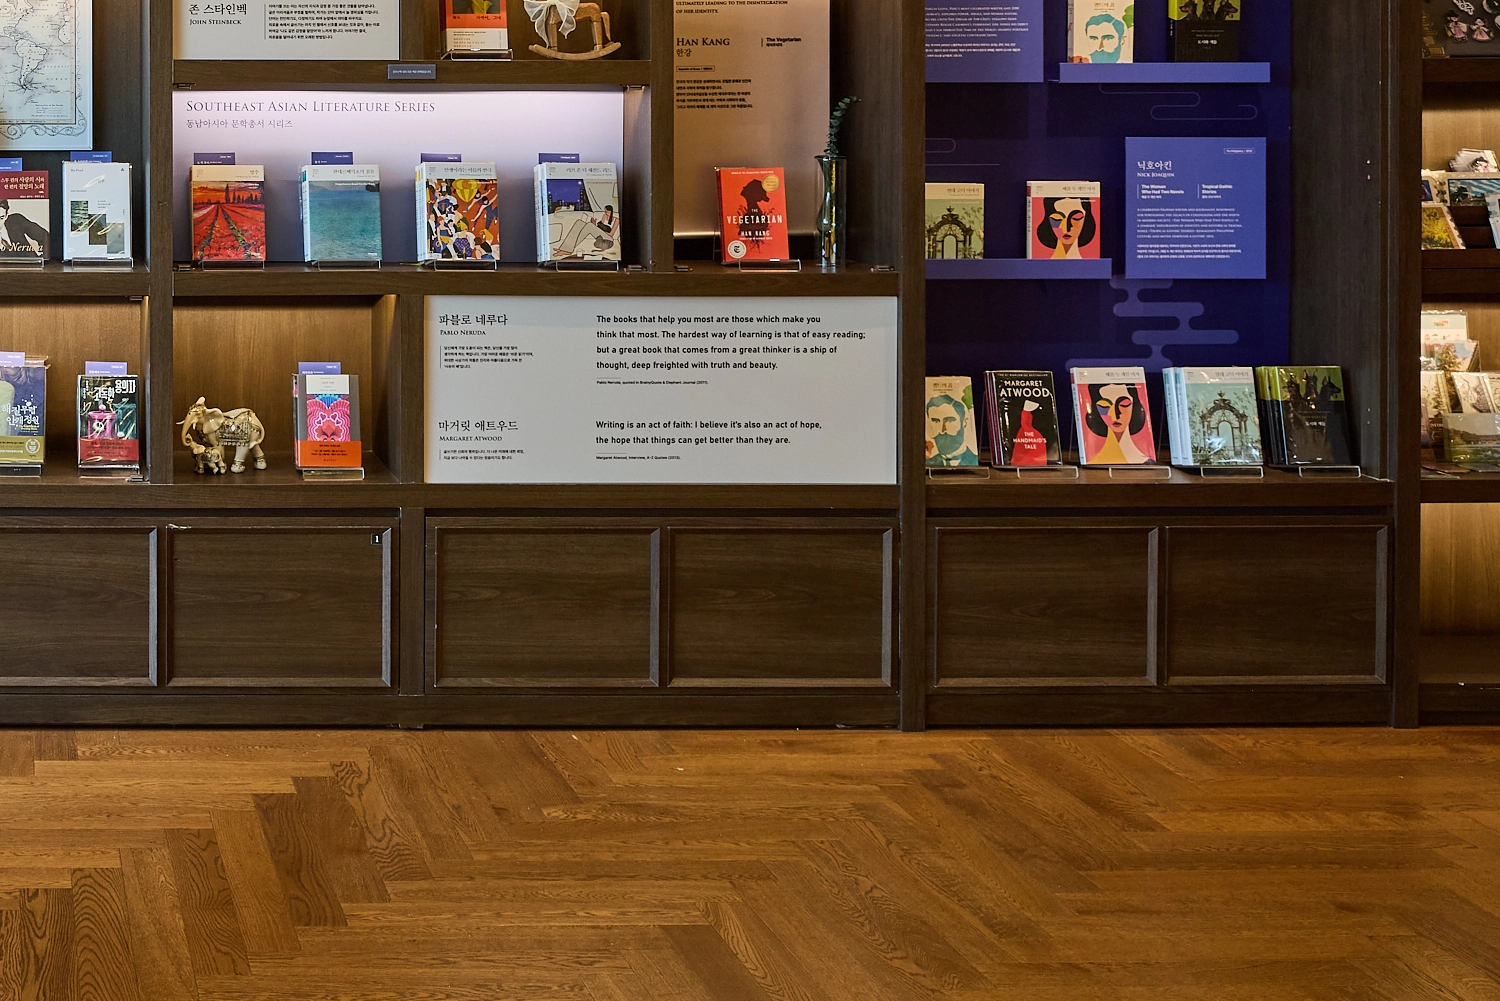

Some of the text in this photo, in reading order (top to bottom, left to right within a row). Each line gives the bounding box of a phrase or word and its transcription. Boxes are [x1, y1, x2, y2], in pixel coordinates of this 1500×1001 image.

[188, 3, 247, 15] 존 스타인벡
[676, 37, 730, 46] HAN KANG
[676, 48, 692, 58] 한강
[186, 100, 435, 112] SOUTHEAST ASIAN LITERATURE SERIES
[186, 118, 293, 129] 동남아시아 문학총서 시리즈
[727, 215, 783, 224] VEGETARIAN
[439, 314, 508, 326] 파블로 네루다
[596, 315, 611, 323] The
[613, 315, 638, 323] books
[640, 315, 656, 323] that
[658, 315, 676, 325] help
[677, 317, 692, 325] you
[731, 315, 754, 323] those
[756, 315, 780, 323] which
[782, 315, 804, 323] make
[806, 317, 821, 325] you
[1000, 388, 1050, 397] ATWOOD
[438, 420, 518, 432] 마거릿 애트우드
